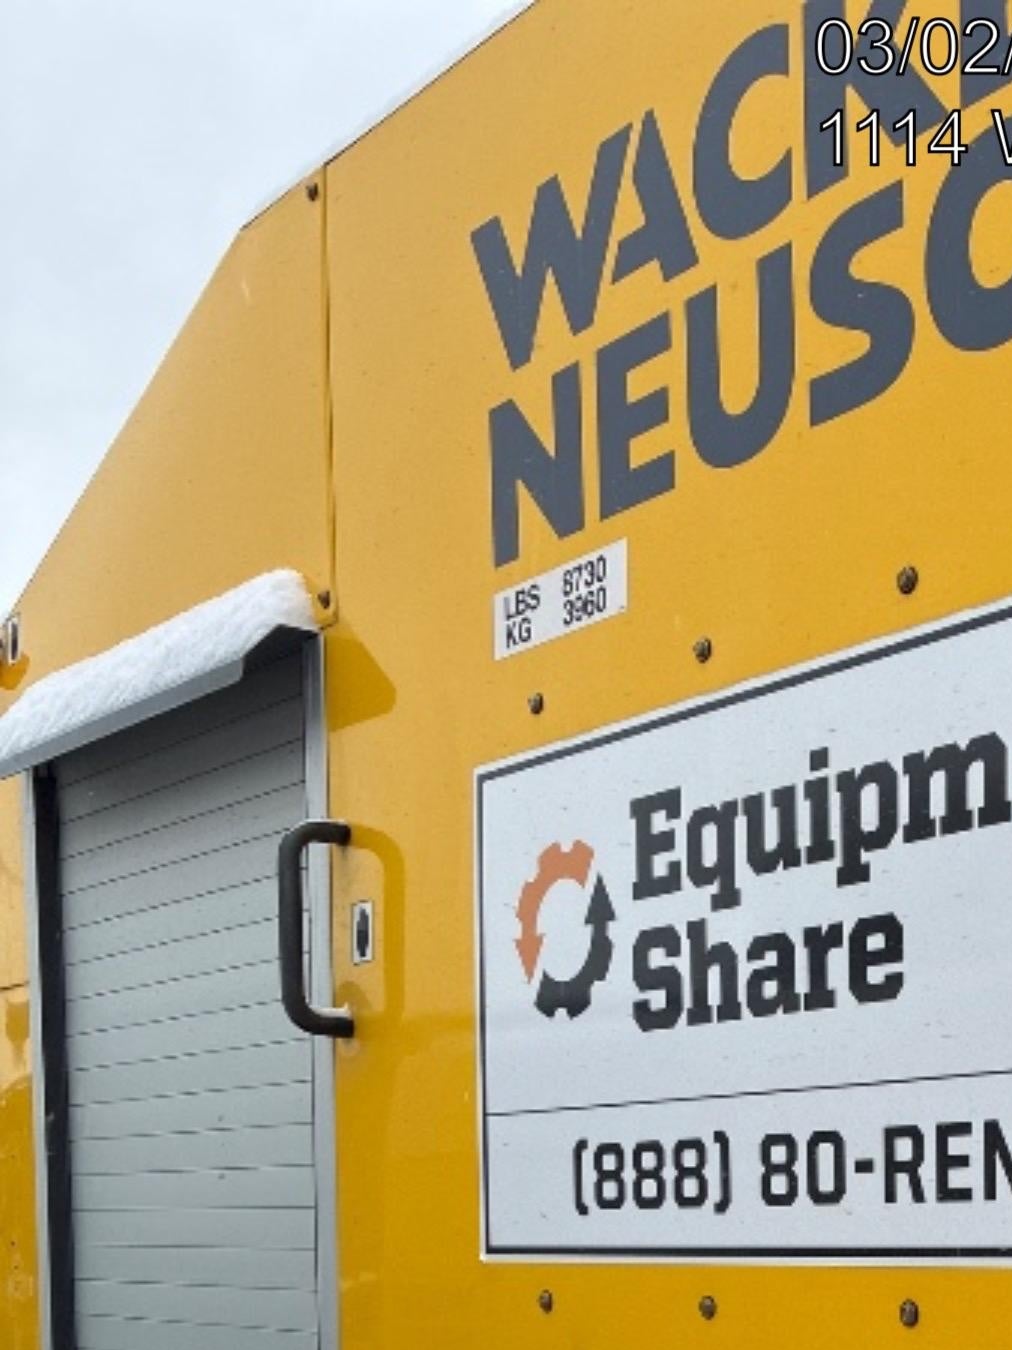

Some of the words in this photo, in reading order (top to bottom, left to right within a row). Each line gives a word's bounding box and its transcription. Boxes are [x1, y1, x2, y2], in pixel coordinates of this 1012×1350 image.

[503, 584, 540, 620] LBS
[506, 616, 531, 648] KG
[632, 911, 904, 1032] Share
[573, 1131, 731, 1216] (888)
